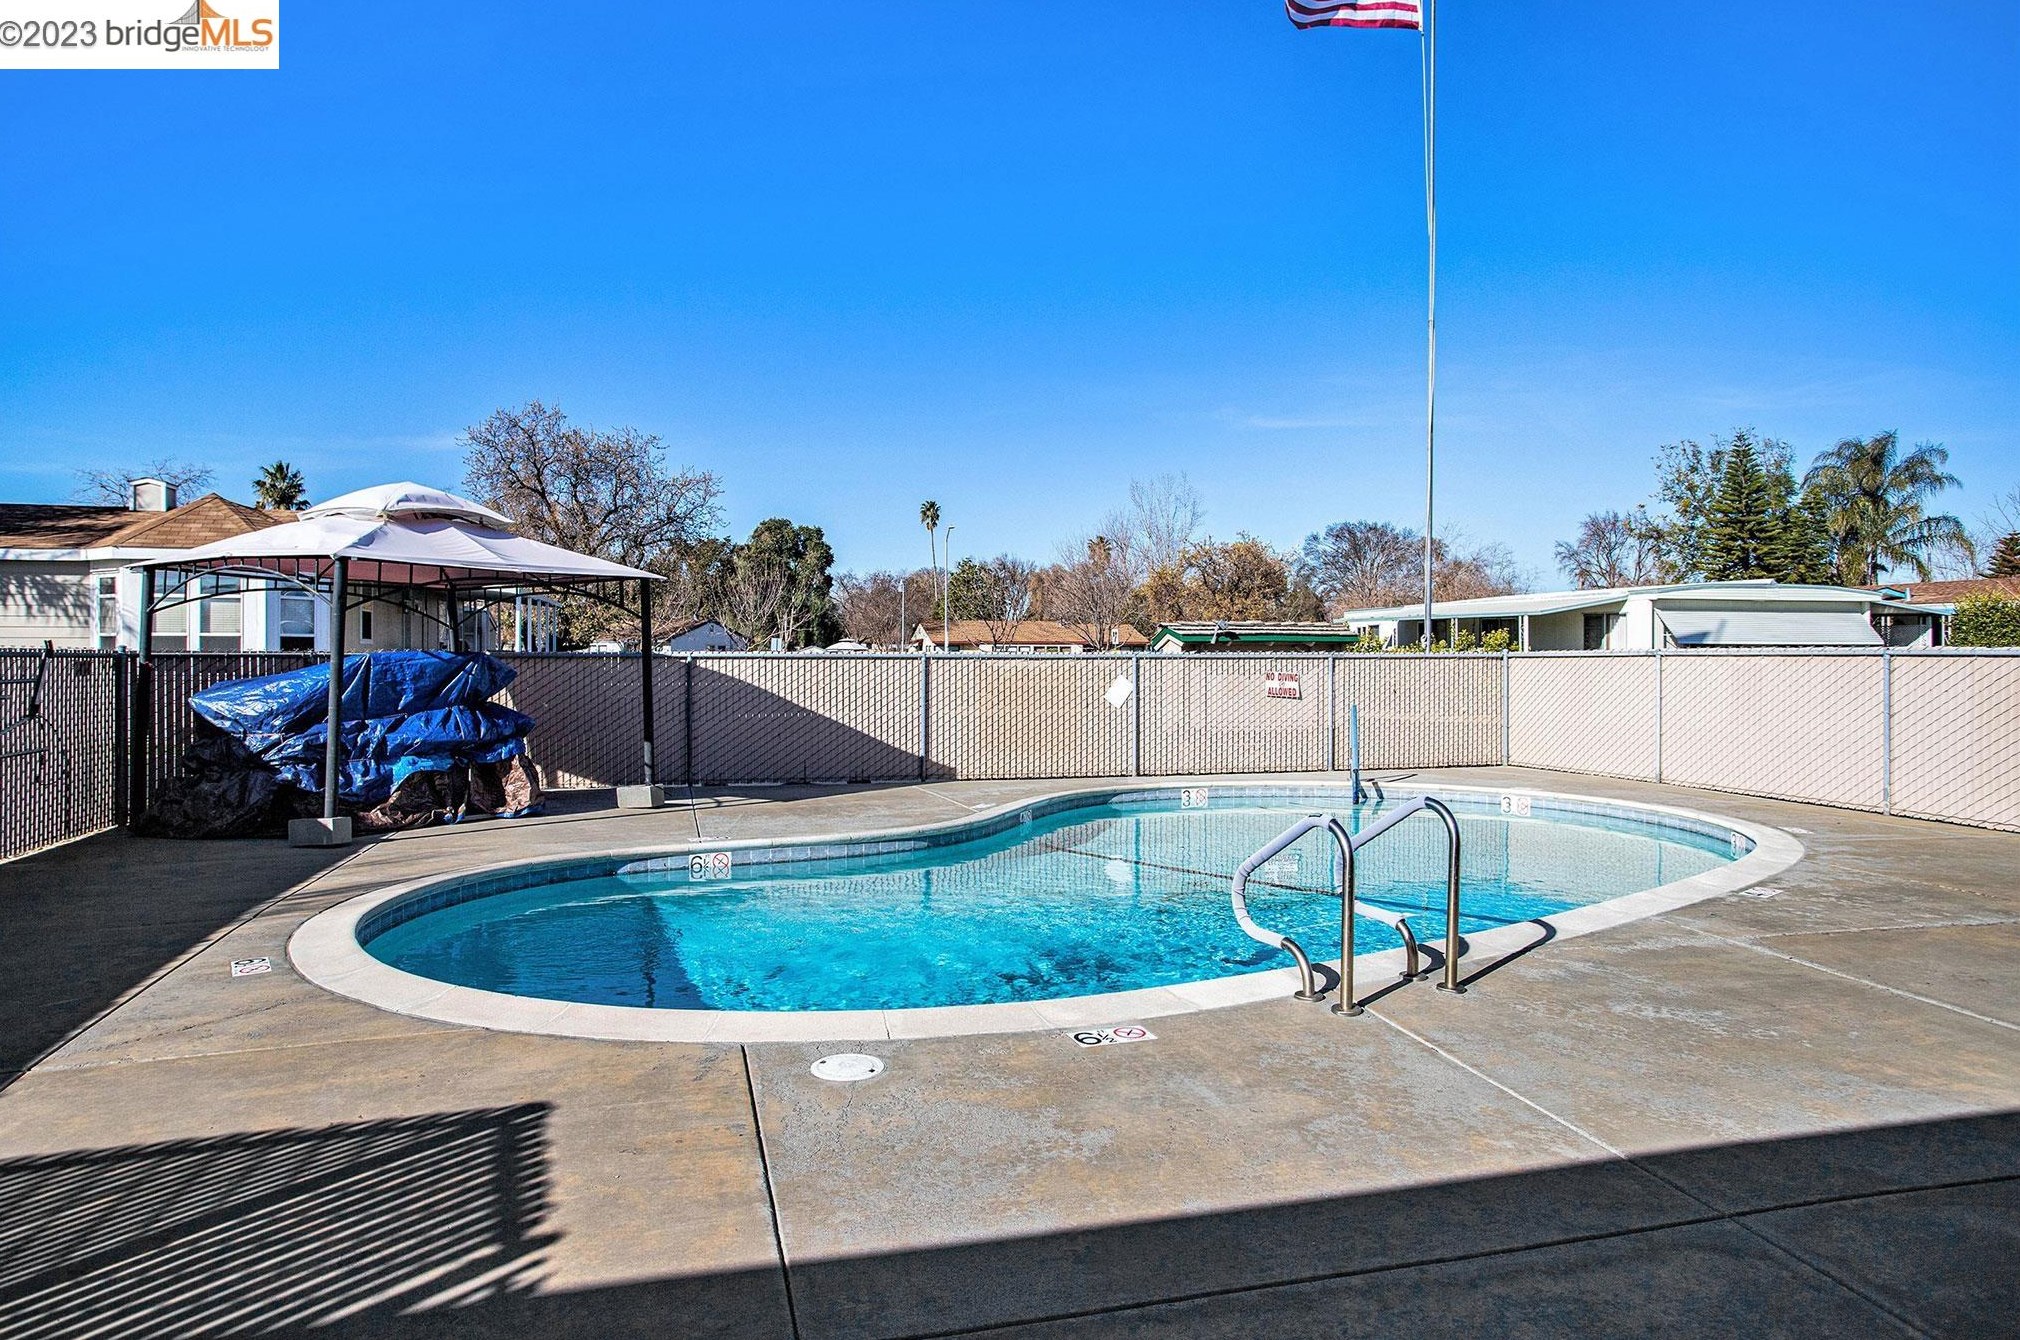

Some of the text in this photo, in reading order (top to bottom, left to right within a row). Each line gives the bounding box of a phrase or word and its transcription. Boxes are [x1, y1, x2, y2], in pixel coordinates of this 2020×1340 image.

[1266, 672, 1298, 682] NO DIVING
[1268, 687, 1296, 696] ALLOWED
